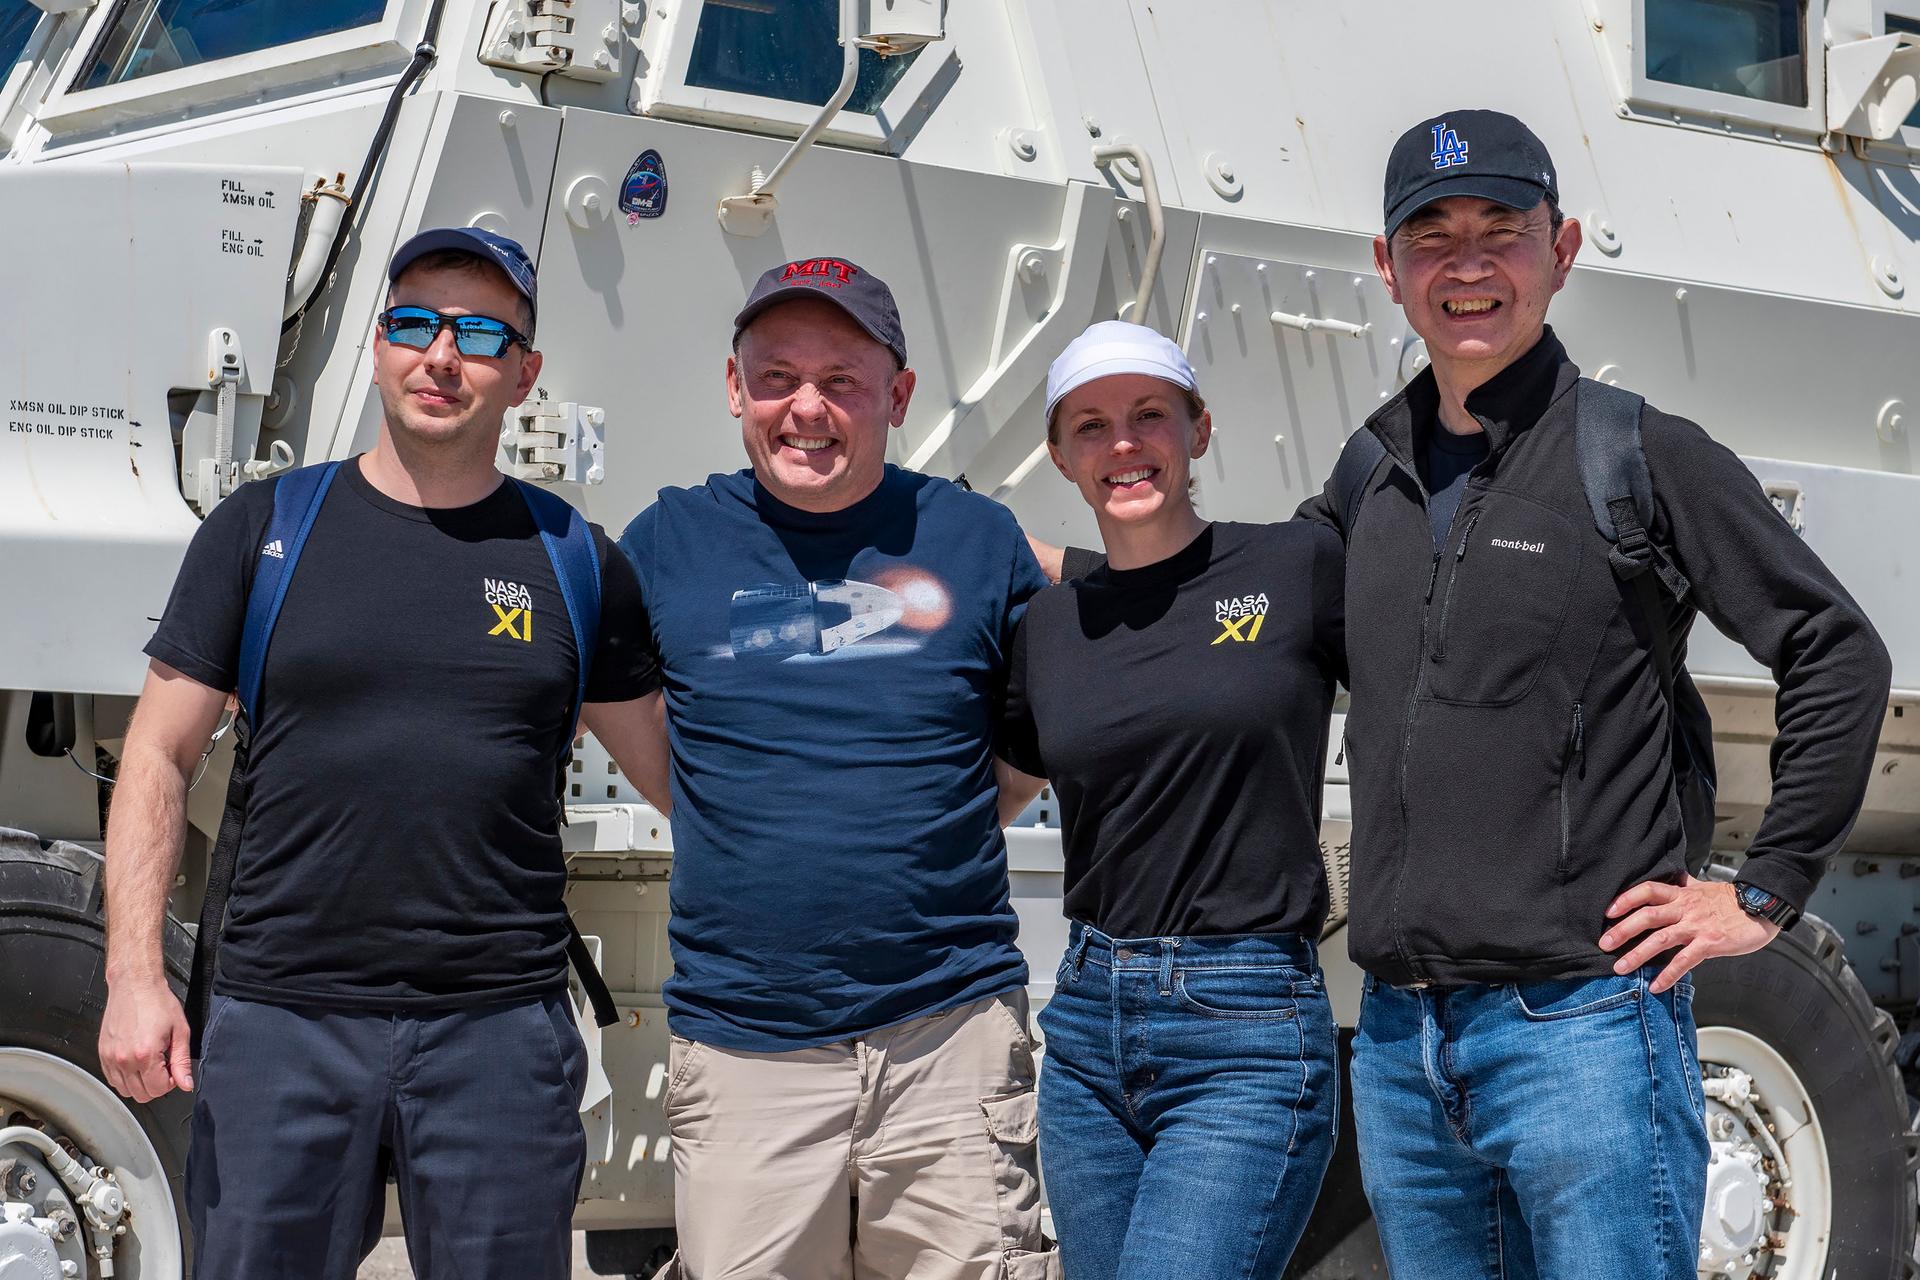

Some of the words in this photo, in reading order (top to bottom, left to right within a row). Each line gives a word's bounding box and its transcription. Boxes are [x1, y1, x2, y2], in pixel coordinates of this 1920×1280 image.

[1430, 122, 1469, 170] LA
[221, 179, 245, 192] FILL
[222, 192, 255, 207] XMSN
[258, 197, 276, 209] OIL
[221, 229, 245, 242] FILL
[222, 242, 243, 254] ENG
[247, 245, 265, 257] OIL
[779, 259, 858, 284] MIT
[9, 399, 44, 413] XMSN
[47, 403, 67, 415] OIL
[69, 404, 88, 417] DIP
[91, 406, 125, 420] STICK
[9, 421, 33, 433] ENG
[36, 423, 55, 435] OIL
[58, 425, 77, 437] DIP
[80, 427, 113, 440] STICK
[483, 577, 532, 600] NASA
[485, 591, 533, 611] CREW
[1215, 592, 1270, 613] NASA
[487, 603, 532, 642] XI
[1215, 604, 1270, 623] CREW
[1210, 614, 1265, 645] XI
